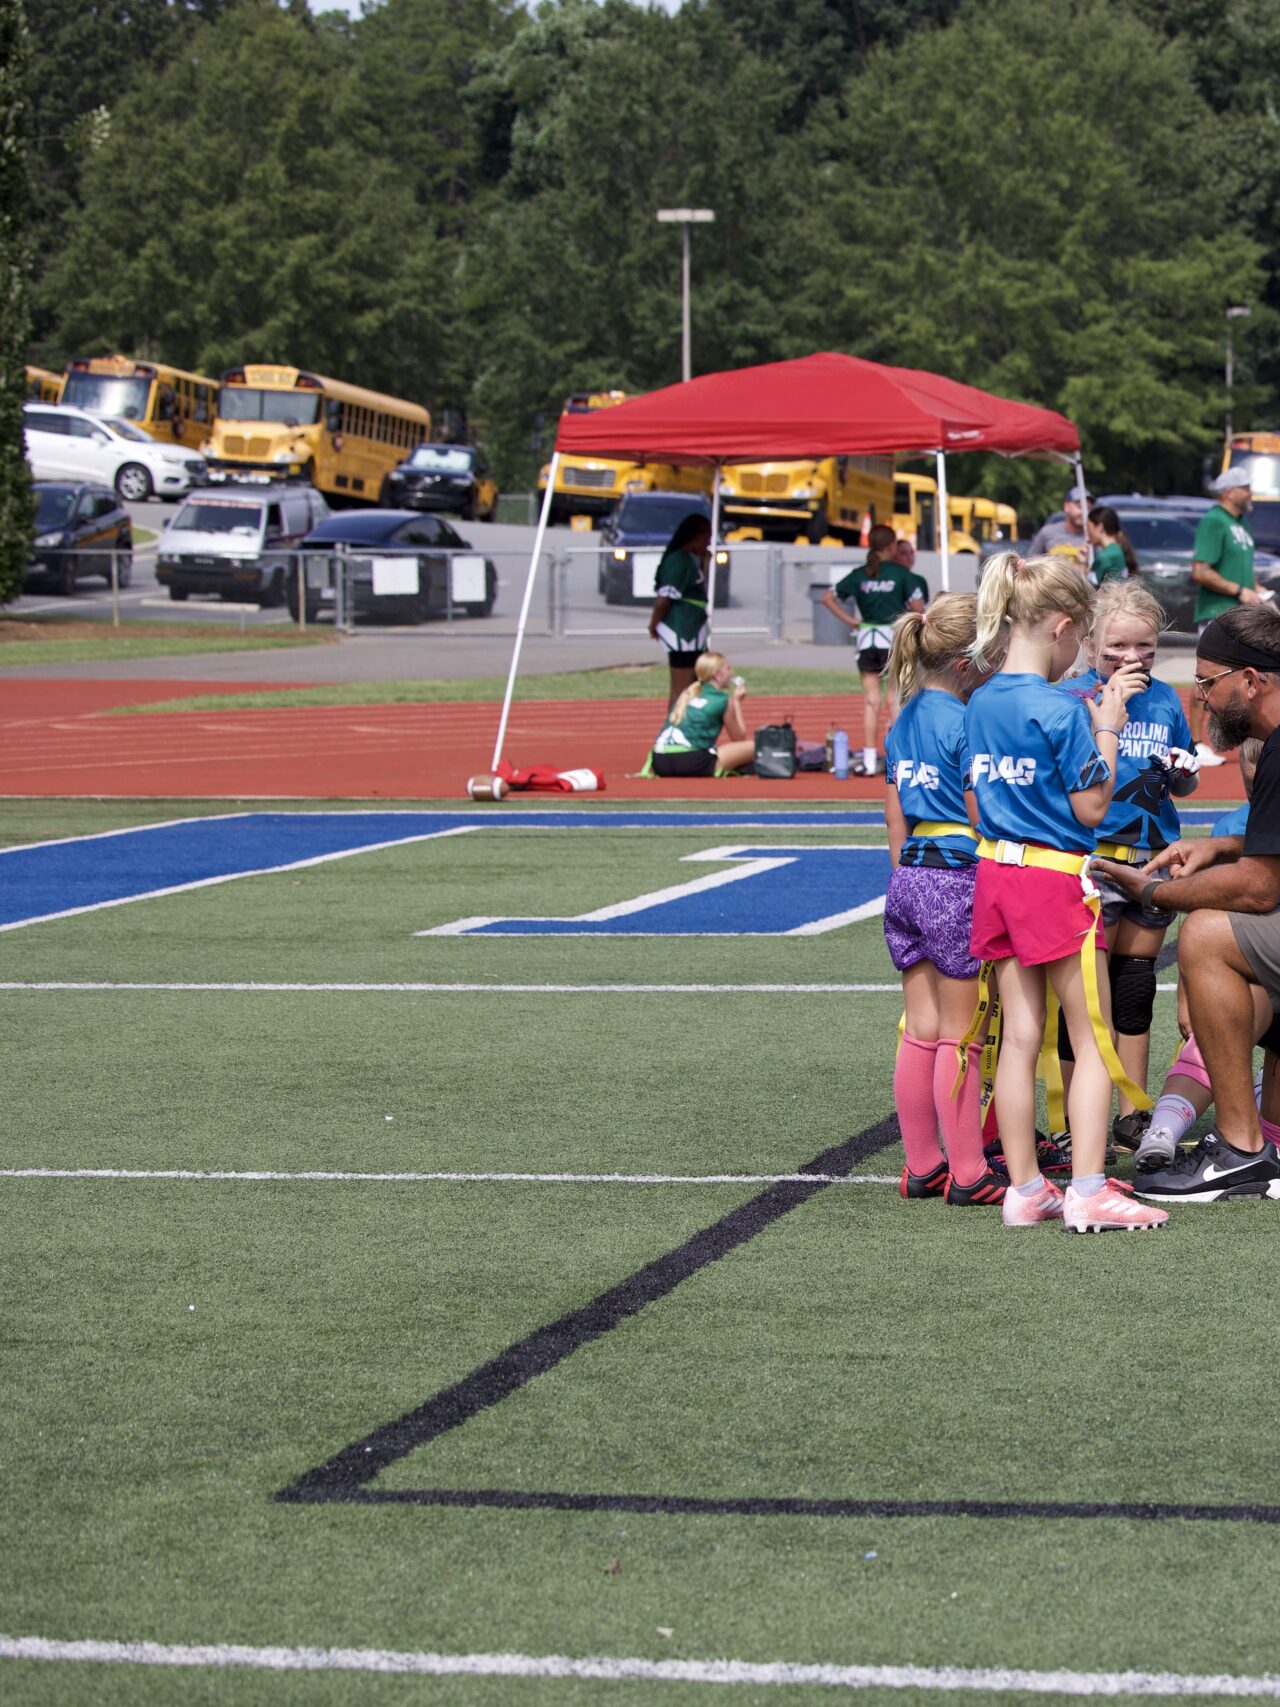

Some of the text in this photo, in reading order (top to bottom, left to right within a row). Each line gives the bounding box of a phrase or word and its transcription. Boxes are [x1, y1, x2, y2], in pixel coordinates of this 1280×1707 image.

[865, 580, 896, 593] FLAG
[973, 754, 1037, 788] FLAG
[981, 1082, 993, 1108] FLAG
